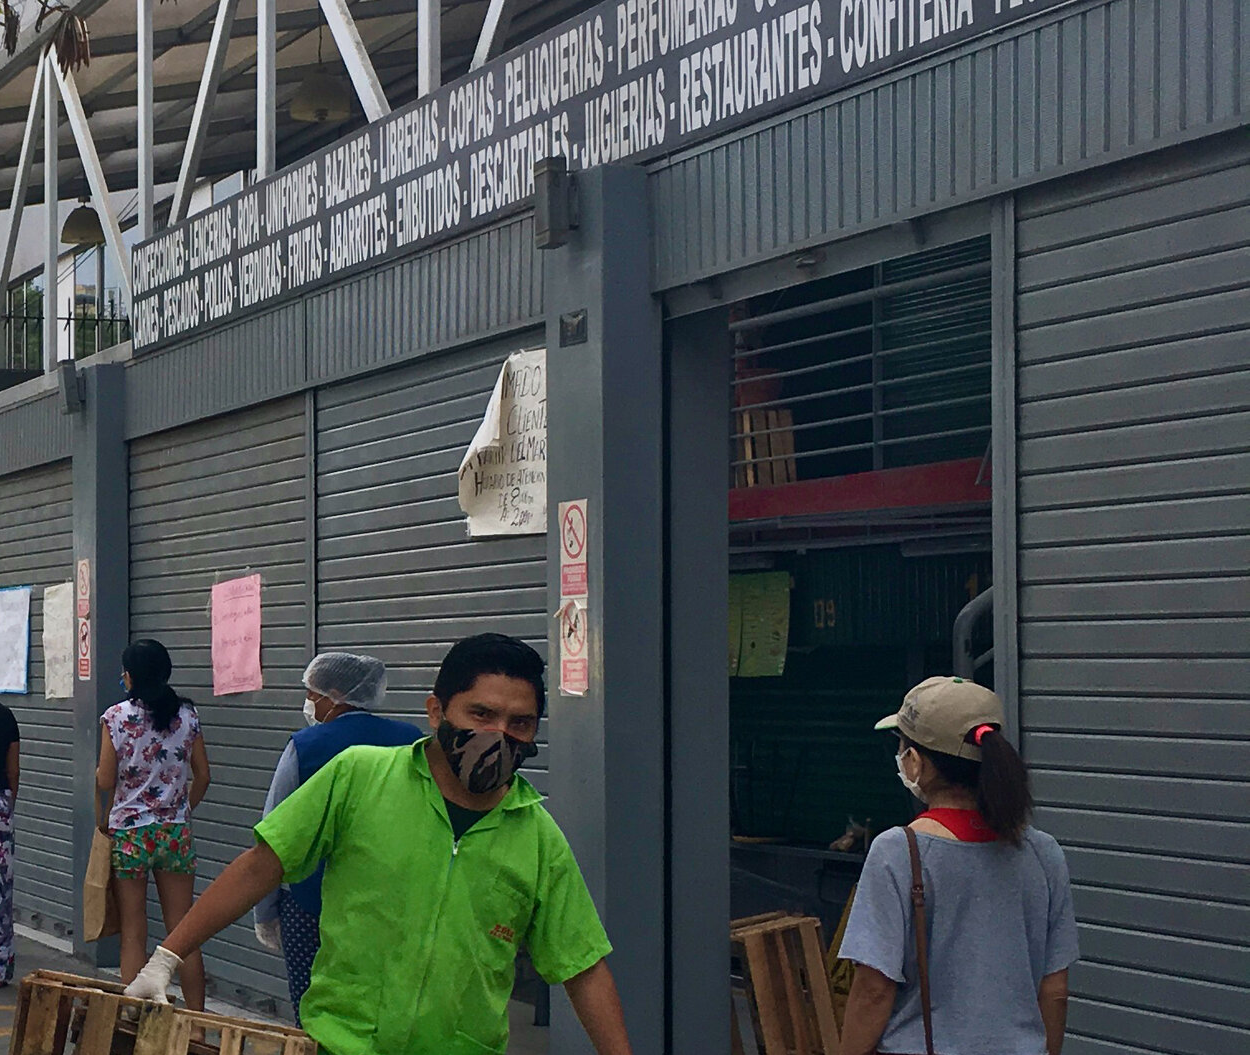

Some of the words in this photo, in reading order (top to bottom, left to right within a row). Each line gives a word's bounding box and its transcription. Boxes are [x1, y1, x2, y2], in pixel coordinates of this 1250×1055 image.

[132, 228, 184, 297] CONFECCIONES
[189, 204, 232, 271] LENCERIAS
[237, 191, 260, 249] ROPA
[266, 160, 318, 237] UNIFORMES
[325, 132, 371, 209] BAZARES
[379, 99, 439, 184] LIBRERIAS
[449, 71, 494, 153] COPIAS
[505, 14, 604, 127] PELUQUERIAS
[134, 293, 159, 350] CARNES
[164, 275, 199, 338] PESCADOS
[204, 261, 233, 322] POLLOS
[238, 239, 282, 308] VERDURAS
[288, 221, 322, 290] FRUTAS
[329, 192, 388, 273] ABARROTES
[396, 160, 461, 247] EMBUTIDOS
[581, 67, 666, 170] JUGUERIAS
[680, 0, 821, 135] RESTAURANTES
